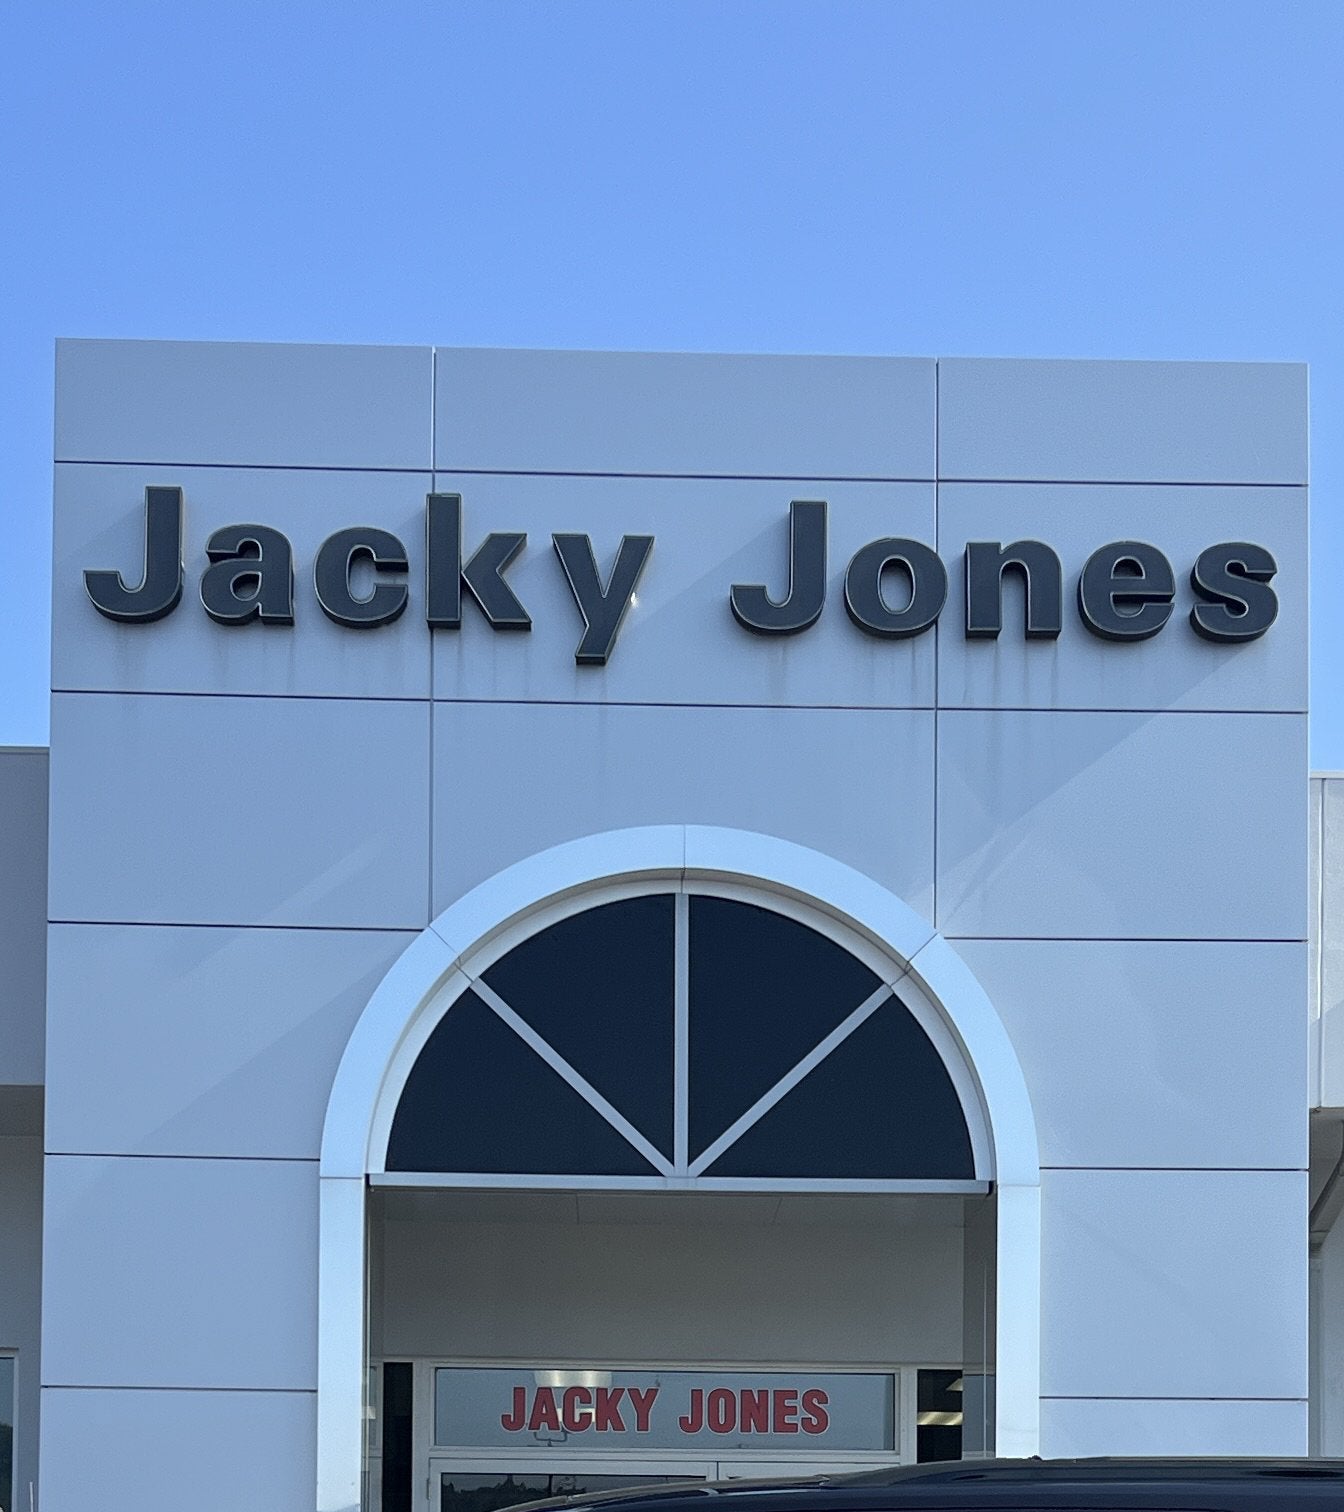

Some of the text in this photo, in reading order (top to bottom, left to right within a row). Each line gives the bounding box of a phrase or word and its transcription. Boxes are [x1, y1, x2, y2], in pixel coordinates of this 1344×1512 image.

[83, 486, 1279, 665] Jacky Jones
[501, 1386, 830, 1434] JACKY JONES
